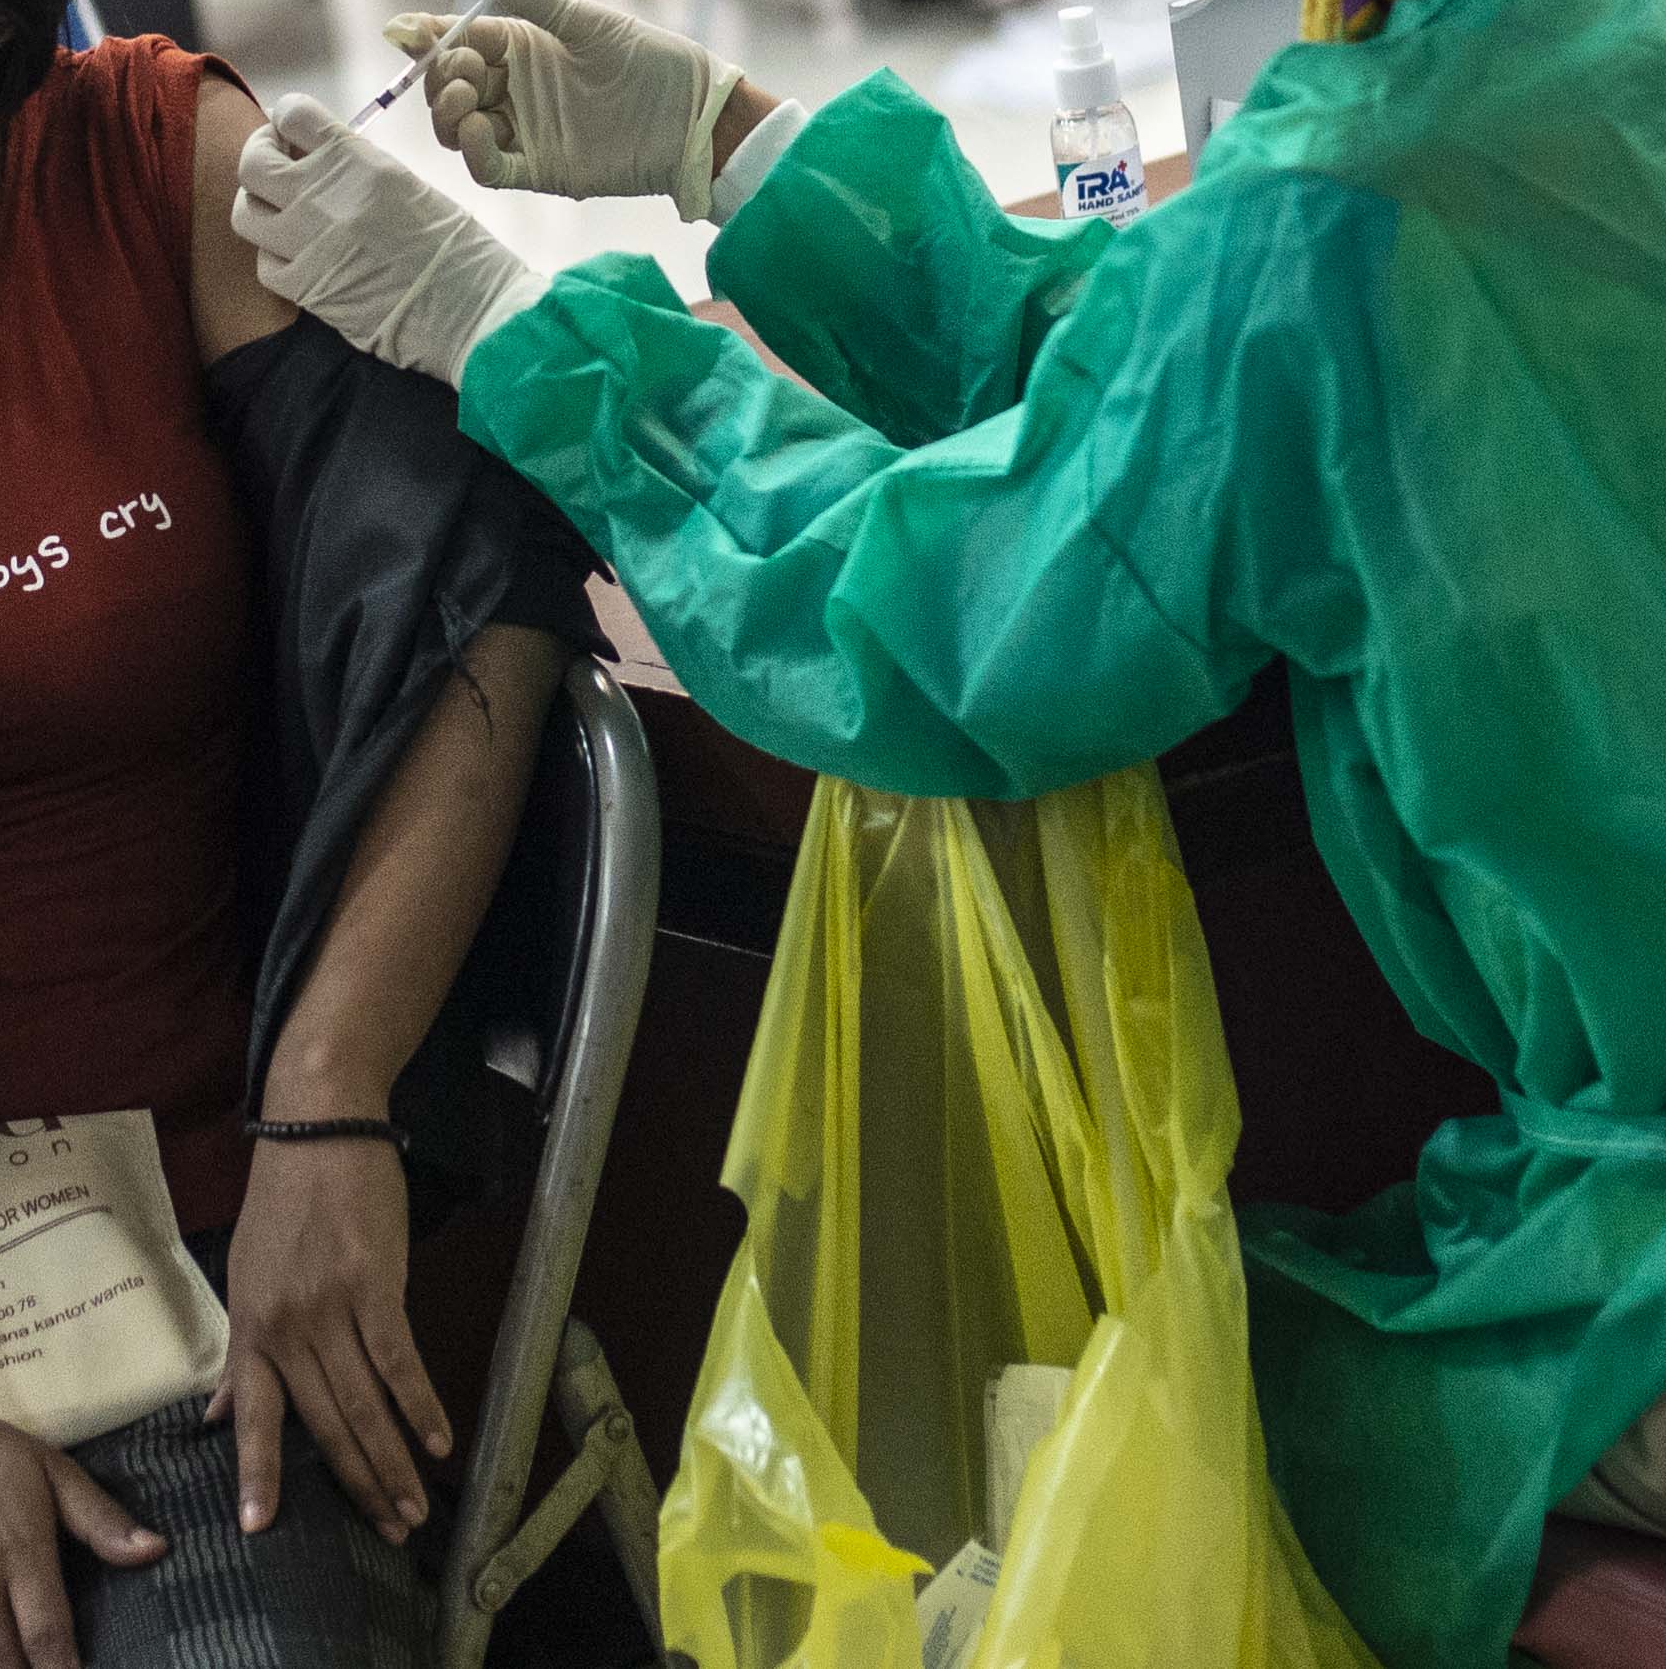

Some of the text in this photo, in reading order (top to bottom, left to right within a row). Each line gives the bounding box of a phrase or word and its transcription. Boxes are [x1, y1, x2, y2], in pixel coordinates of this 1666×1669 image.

[1076, 167, 1130, 201] IRA
[1078, 197, 1114, 212] HAND
[99, 492, 173, 540] cry
[21, 1184, 91, 1219] WOMEN
